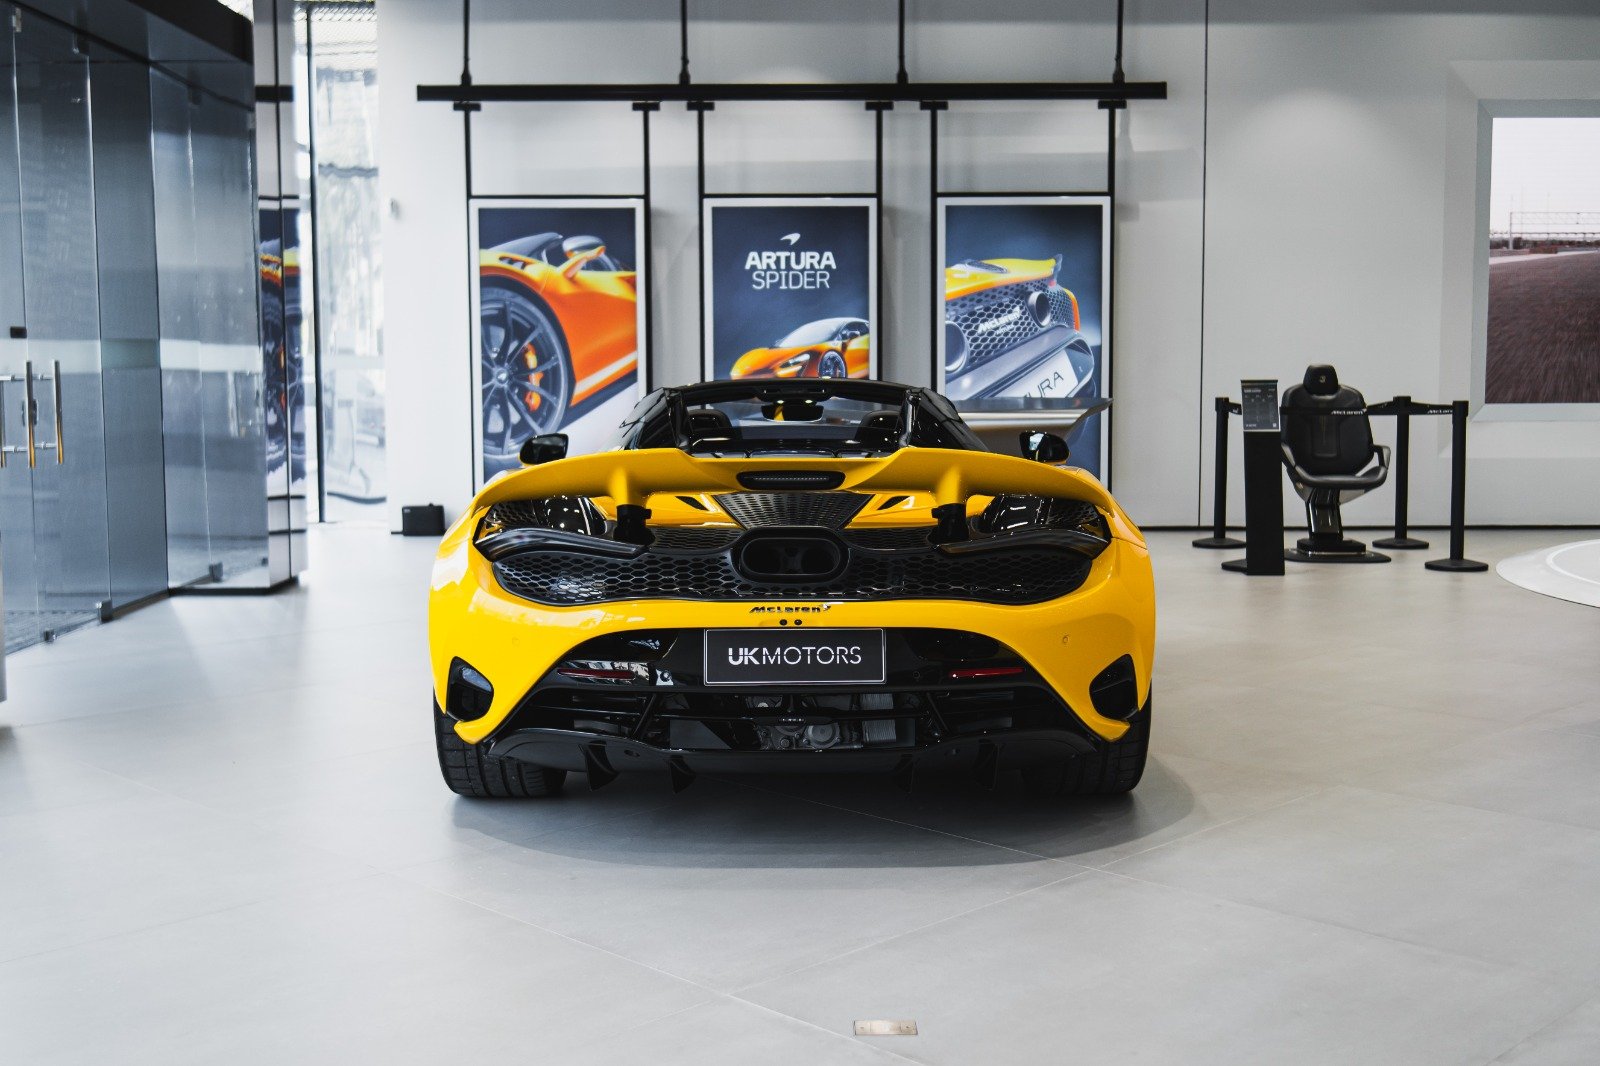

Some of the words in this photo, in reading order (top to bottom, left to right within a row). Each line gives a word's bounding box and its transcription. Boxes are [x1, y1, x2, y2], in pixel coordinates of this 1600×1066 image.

[745, 251, 836, 270] ARTURA
[752, 270, 830, 289] SPIDER
[750, 605, 821, 613] McLaren
